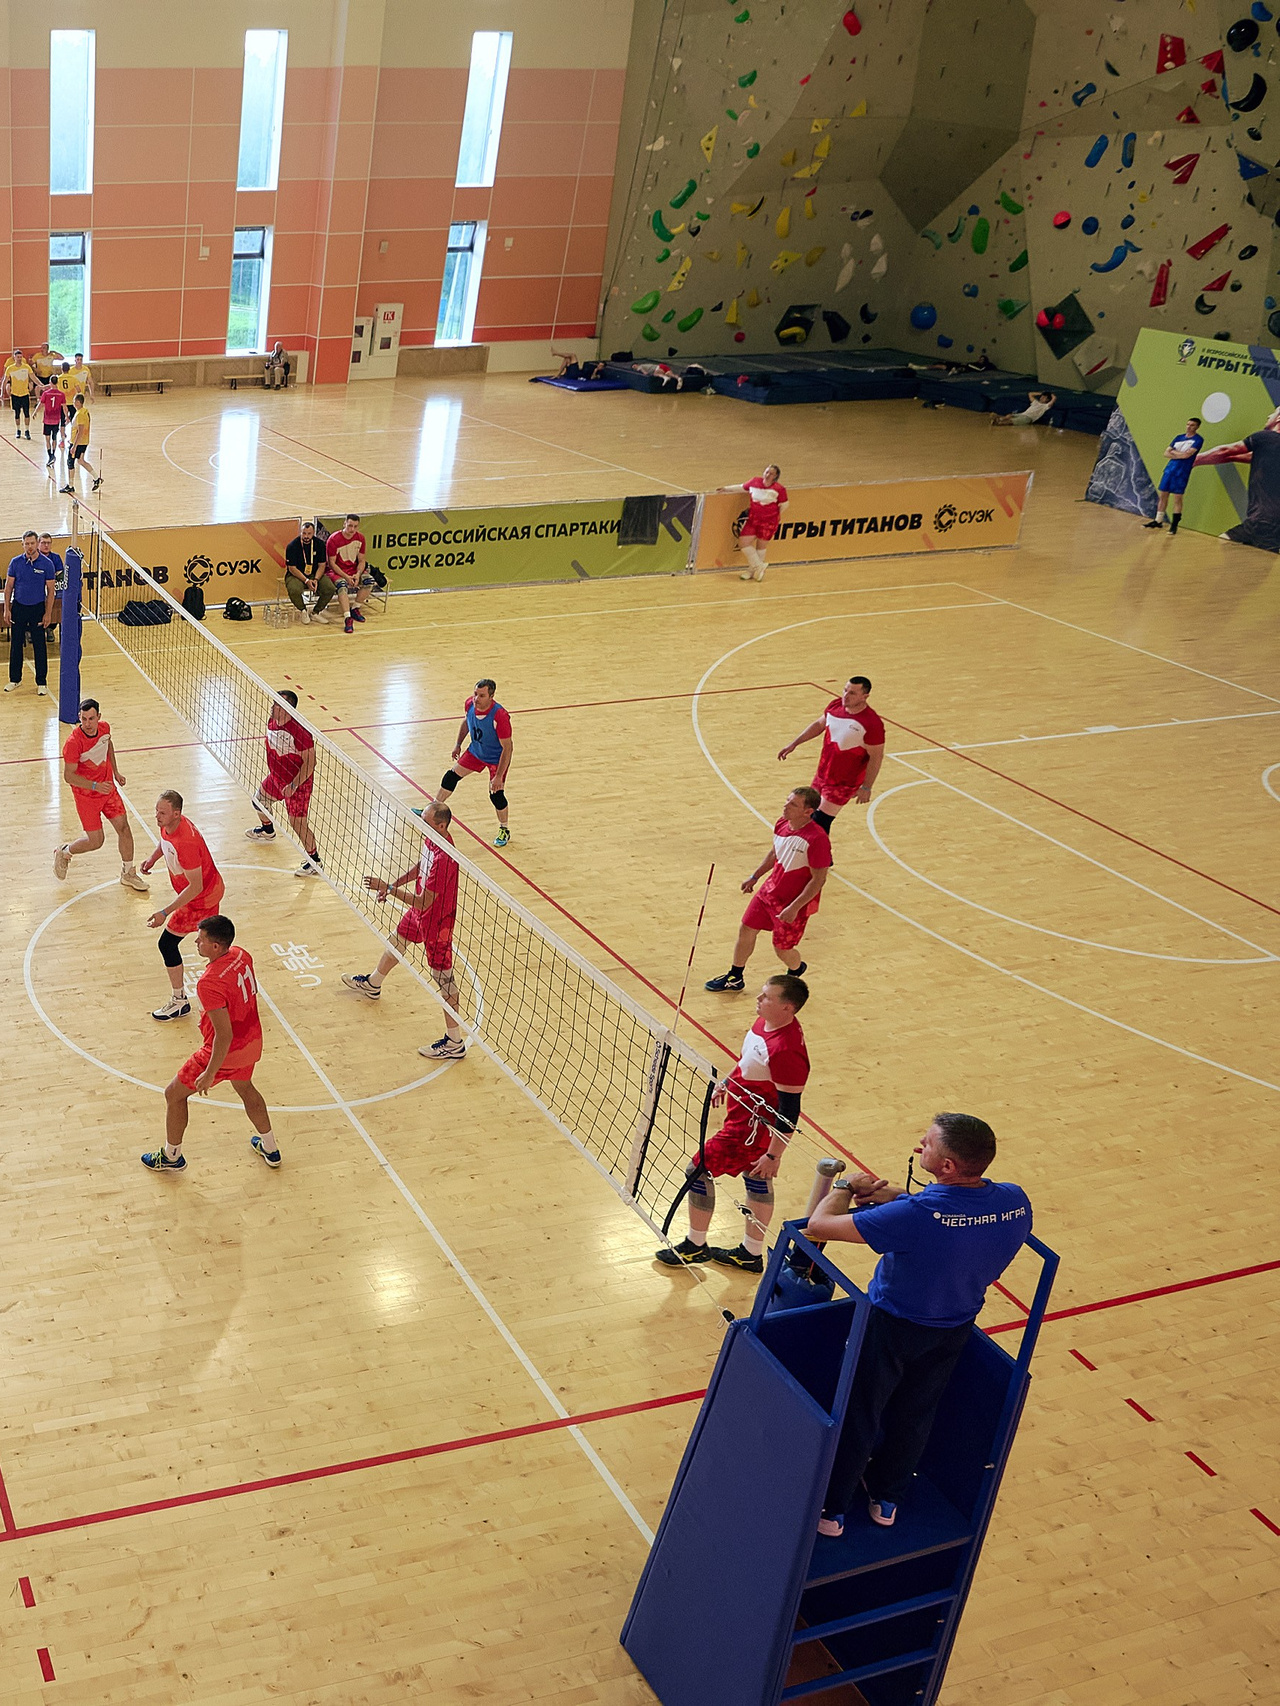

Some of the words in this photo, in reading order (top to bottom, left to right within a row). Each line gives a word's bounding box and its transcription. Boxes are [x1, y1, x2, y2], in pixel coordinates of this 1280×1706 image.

[1197, 355, 1240, 373] ИГРЫ
[1242, 363, 1280, 379] ТИТА
[62, 379, 69, 390] 6
[50, 396, 56, 408] 1
[830, 513, 923, 536] ТИТАНОВ
[958, 508, 995, 524] СУЭК
[386, 525, 531, 548] ВСЕРОССИЙСКАЯ
[534, 519, 621, 538] СПАРТАКИ
[216, 558, 262, 576] СУЭК
[387, 553, 433, 570] СУЭК
[434, 551, 476, 567] 2024
[82, 566, 169, 590] ТАНОВ
[237, 964, 257, 1003] 11
[941, 1213, 997, 1227] ЧЕСТНАЯ
[1001, 1206, 1026, 1221] ИГРА
